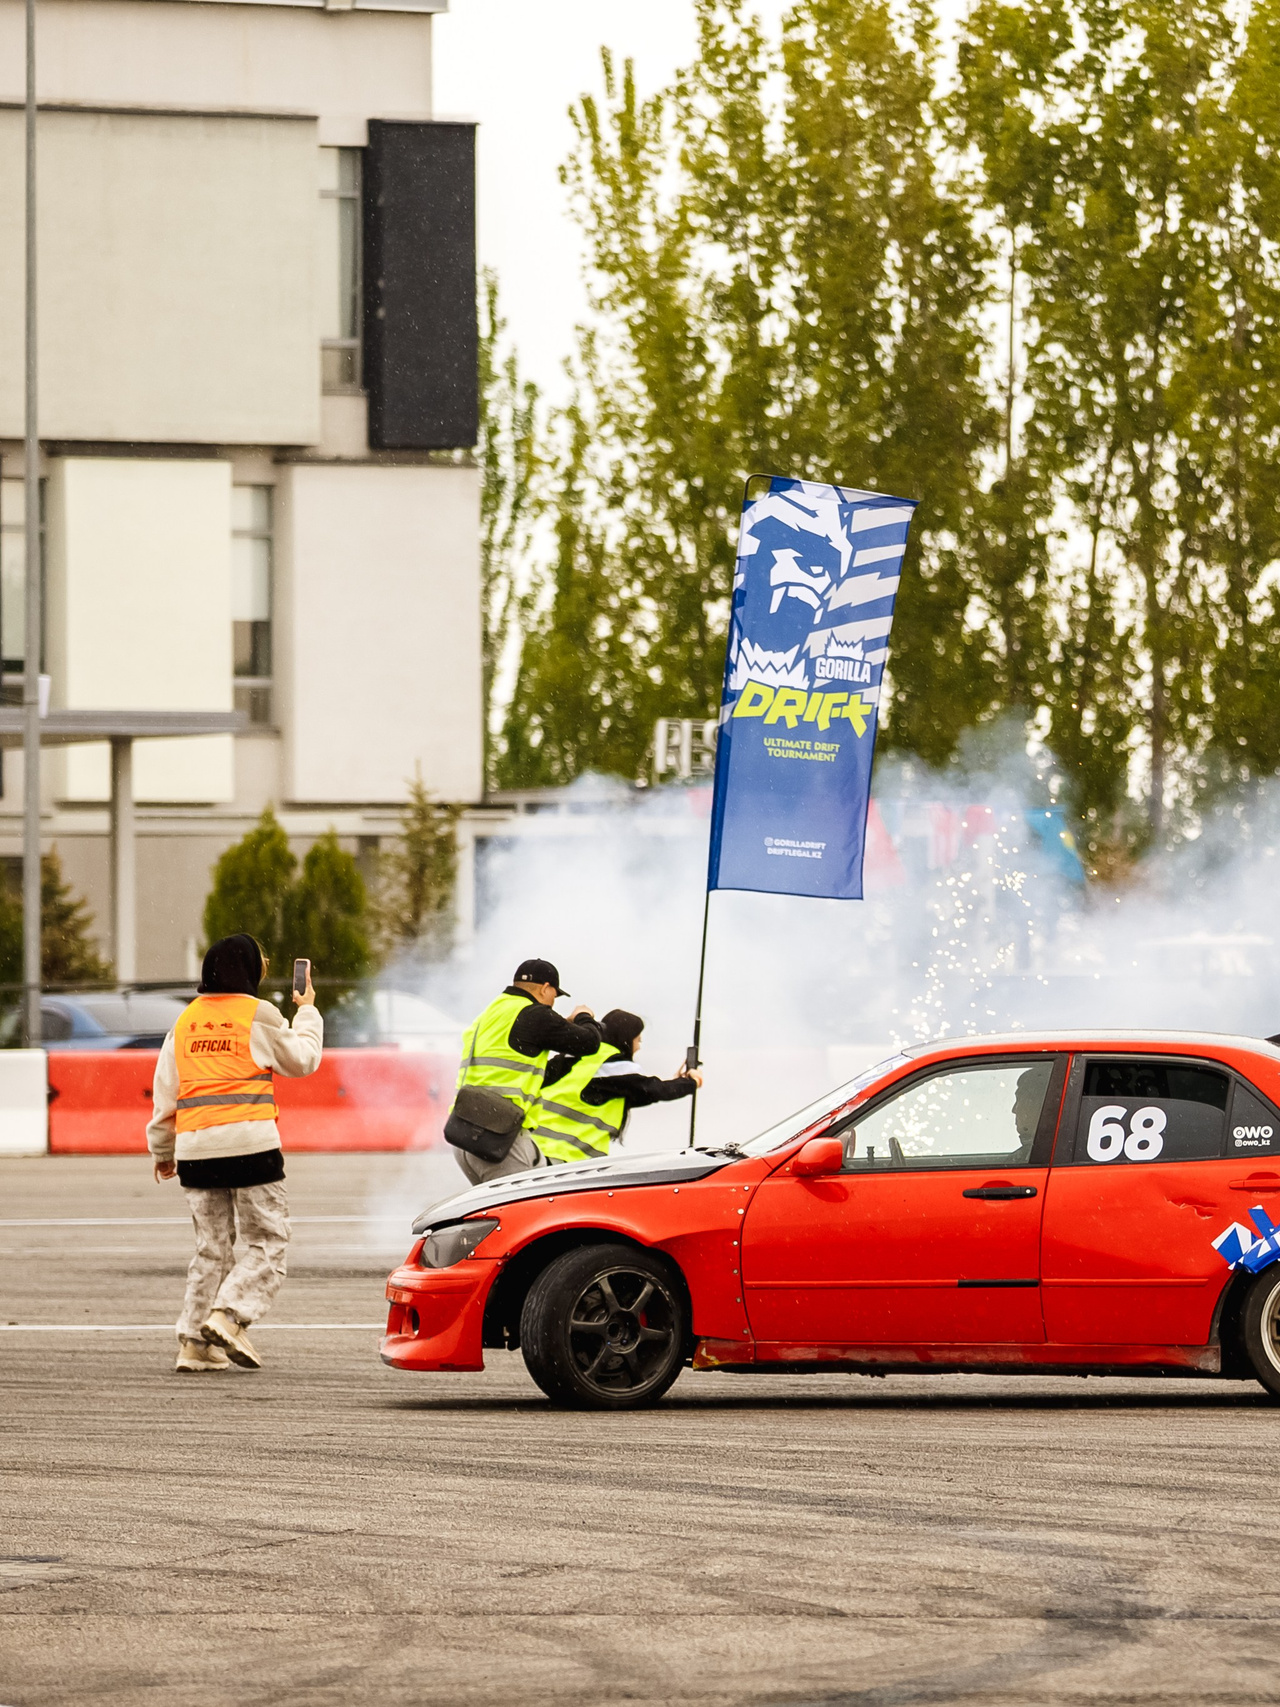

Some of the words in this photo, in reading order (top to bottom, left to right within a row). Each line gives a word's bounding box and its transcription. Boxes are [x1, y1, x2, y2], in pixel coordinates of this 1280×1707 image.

[815, 657, 872, 684] GORILLA
[732, 680, 873, 739] DRIFT
[763, 737, 812, 750] ULTIMATE
[814, 742, 840, 752] DRIFT
[767, 748, 836, 762] TOURNAMENT
[190, 1040, 231, 1053] OFFICIAL
[1087, 1105, 1167, 1162] 68
